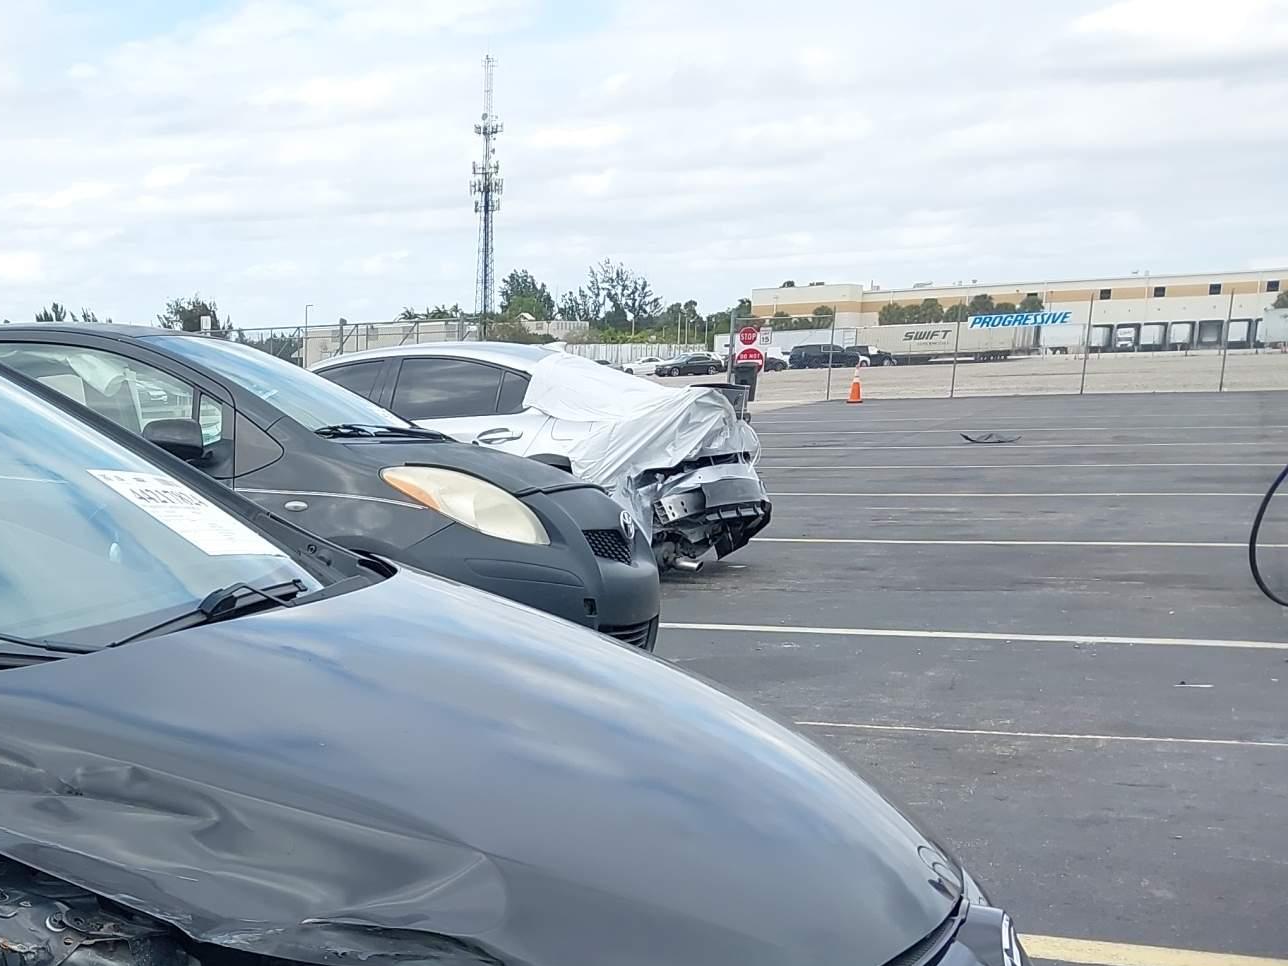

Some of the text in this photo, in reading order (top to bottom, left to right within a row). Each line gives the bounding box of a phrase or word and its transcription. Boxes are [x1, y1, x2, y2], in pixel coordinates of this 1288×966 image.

[969, 311, 1073, 329] PROGRESSIVE
[740, 332, 757, 340] STOP
[902, 329, 953, 341] SWIFT
